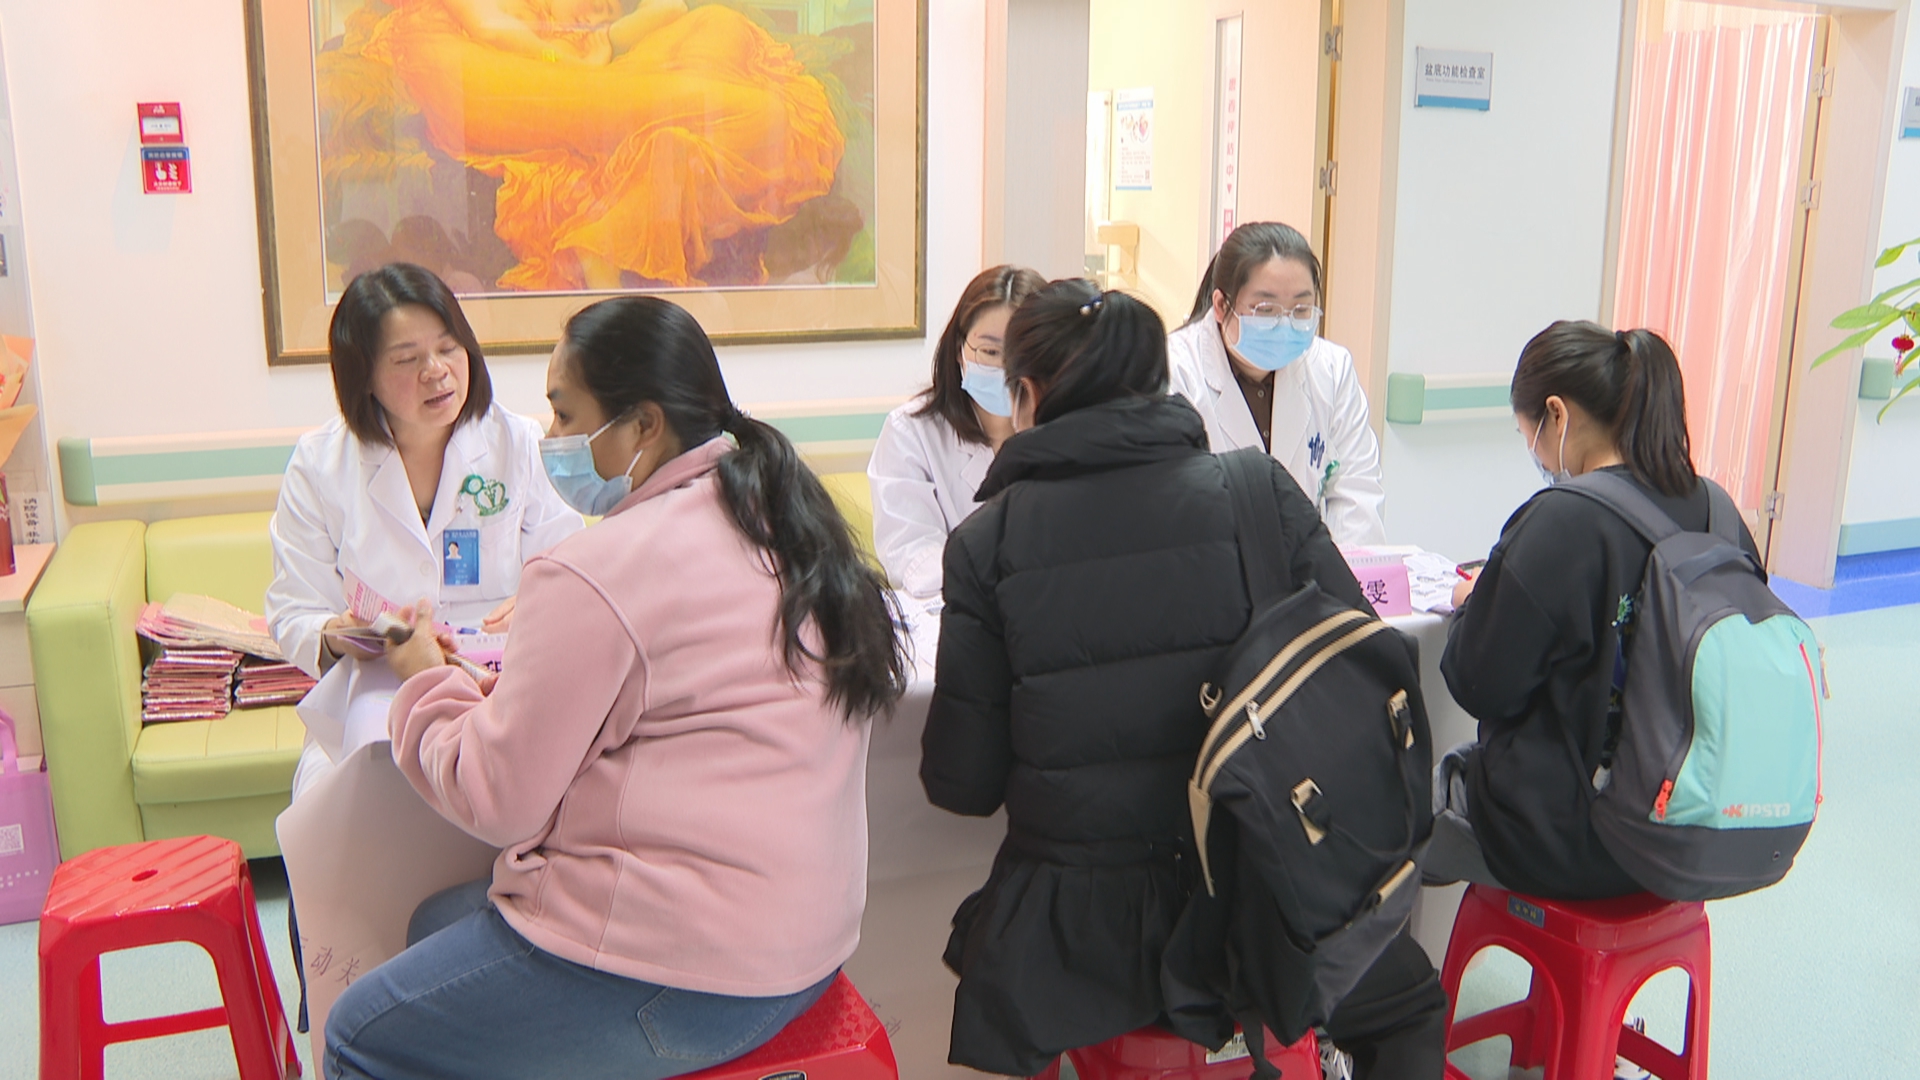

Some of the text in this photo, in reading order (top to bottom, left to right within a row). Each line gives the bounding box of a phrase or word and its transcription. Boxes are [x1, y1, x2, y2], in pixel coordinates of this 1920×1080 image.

[1425, 62, 1485, 79] 盆底功能检查室
[1359, 579, 1388, 605] 雯
[1727, 802, 1791, 818] KIPSTA
